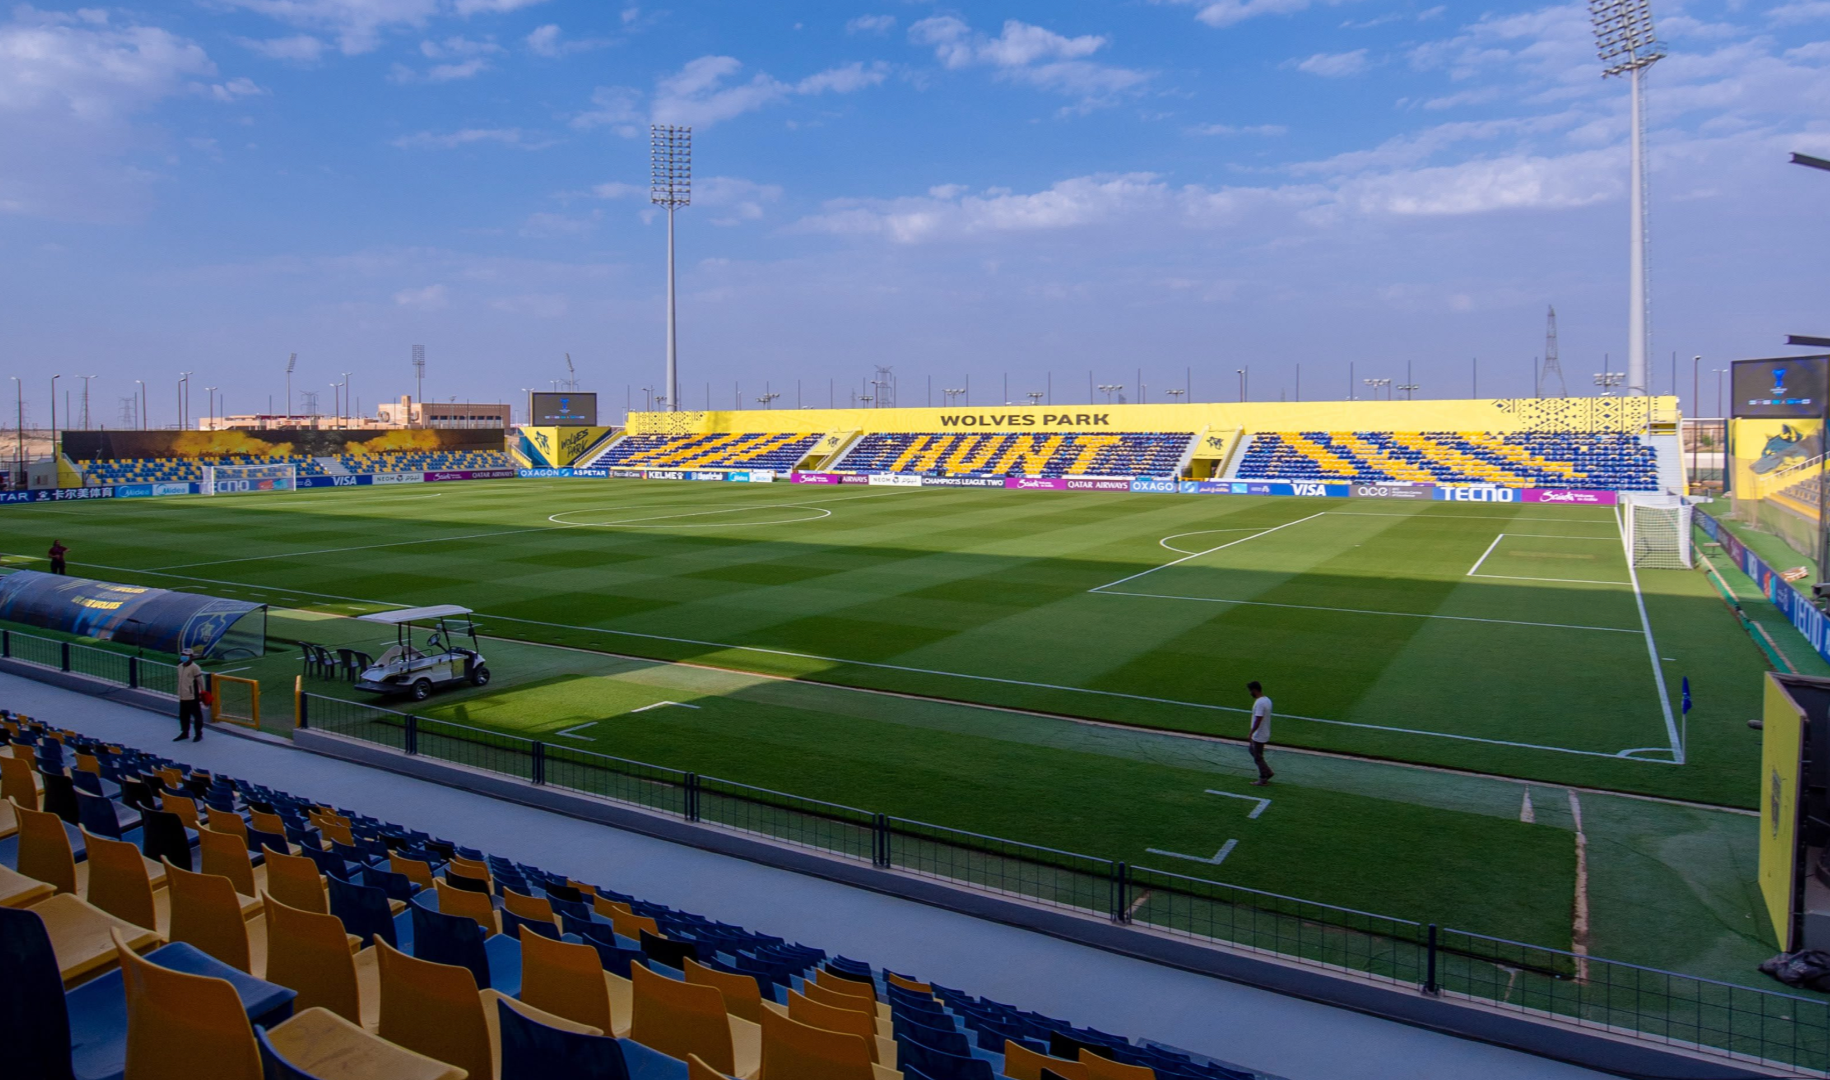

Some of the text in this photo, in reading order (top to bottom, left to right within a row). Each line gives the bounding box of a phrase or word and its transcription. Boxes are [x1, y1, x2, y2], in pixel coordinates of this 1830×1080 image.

[940, 413, 1110, 427] WOLVES PARK
[561, 429, 588, 450] WOLVES
[567, 439, 588, 458] PARK
[889, 435, 1124, 474] HUNT
[331, 475, 357, 486] VISA
[648, 471, 676, 480] KELME
[842, 475, 868, 483] AIRWAYS
[961, 478, 986, 486] LEAGUE
[987, 479, 1004, 487] TWO
[1067, 480, 1128, 489] QATAR AIRWAYS
[51, 487, 113, 500] 卡尔美体育
[1290, 483, 1327, 496] VISA
[1358, 486, 1389, 497] ace
[1440, 486, 1514, 502] TECNO
